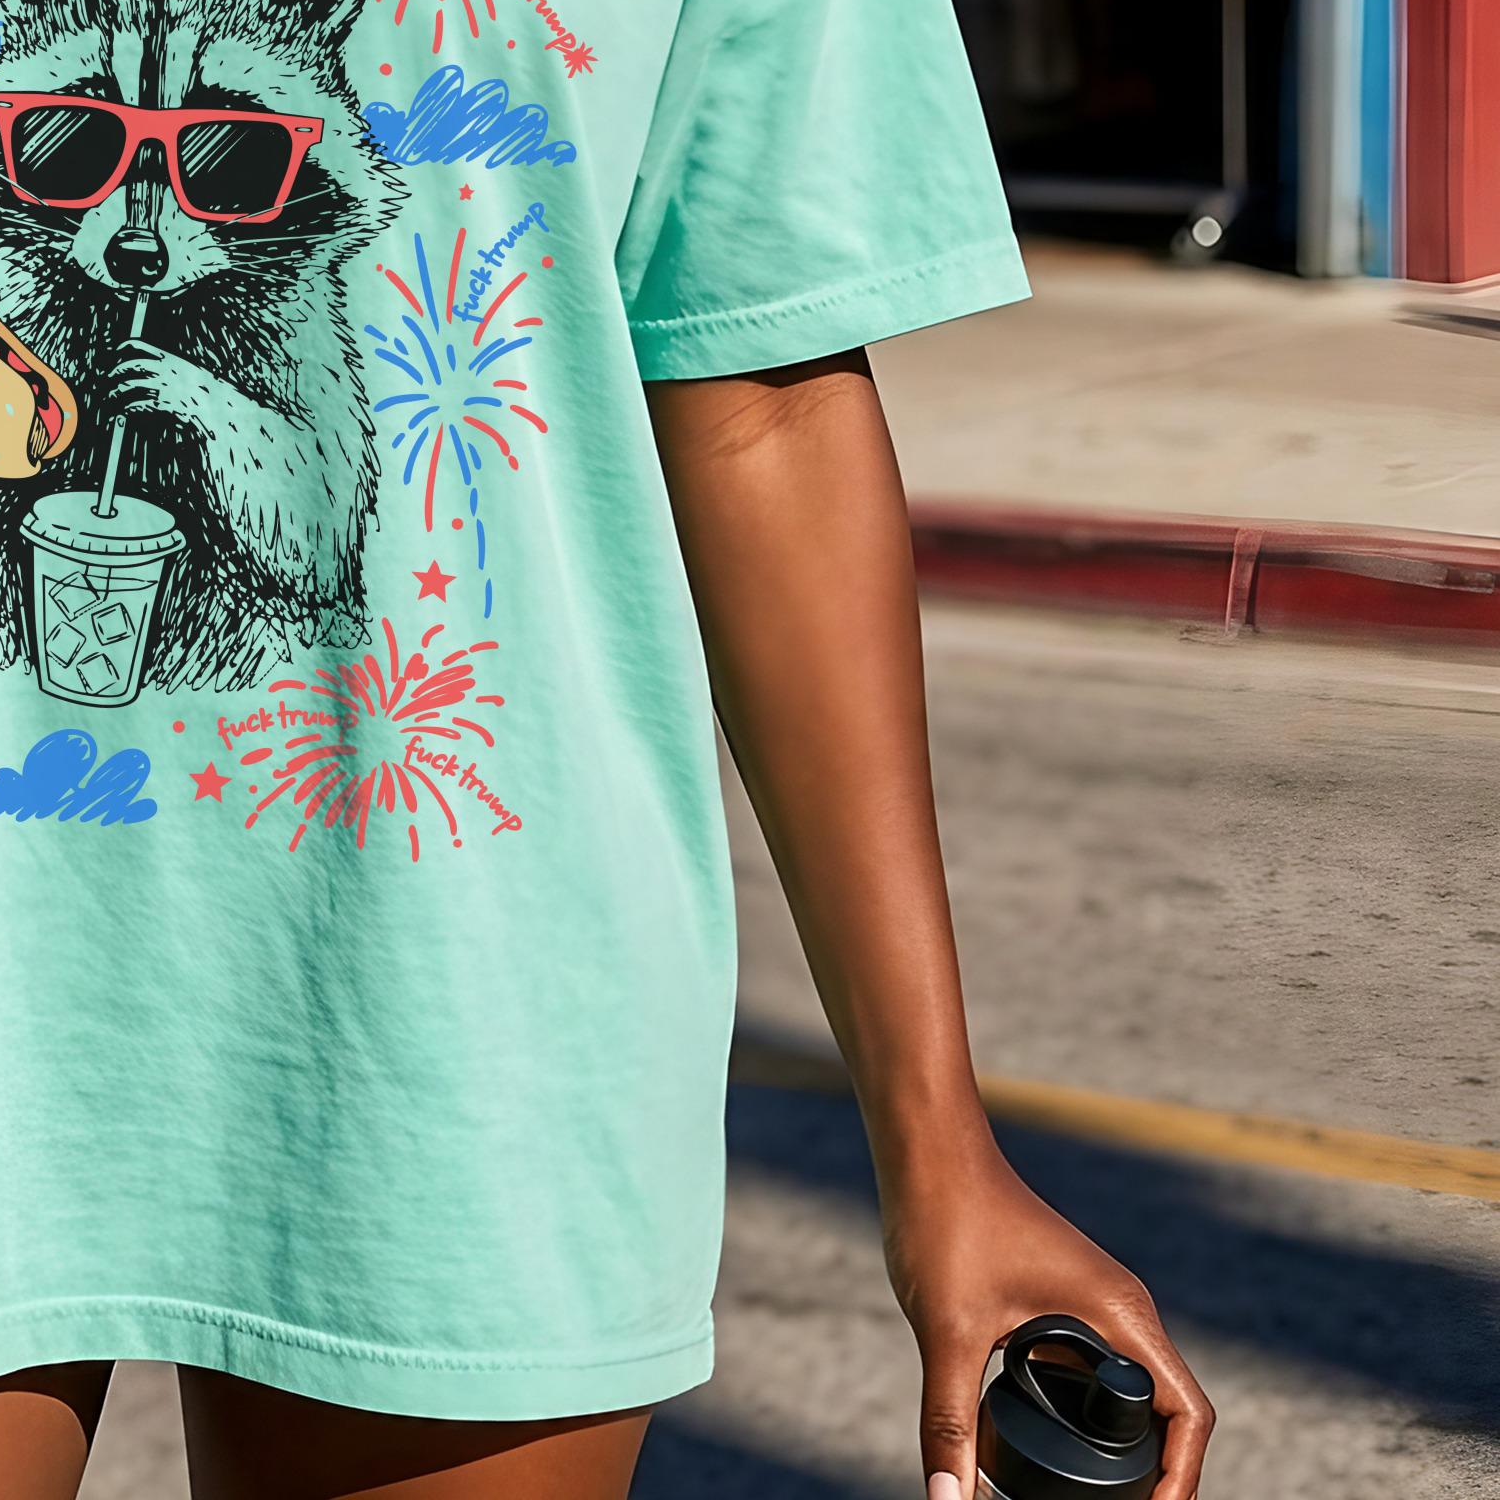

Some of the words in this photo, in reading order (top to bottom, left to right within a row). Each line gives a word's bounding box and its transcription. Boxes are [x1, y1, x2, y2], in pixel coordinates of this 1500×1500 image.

[451, 266, 494, 323] fuck
[477, 202, 550, 267] trump
[217, 707, 274, 750] fuck
[276, 700, 359, 743] trump
[403, 735, 460, 777] fuck
[458, 762, 523, 836] trump
